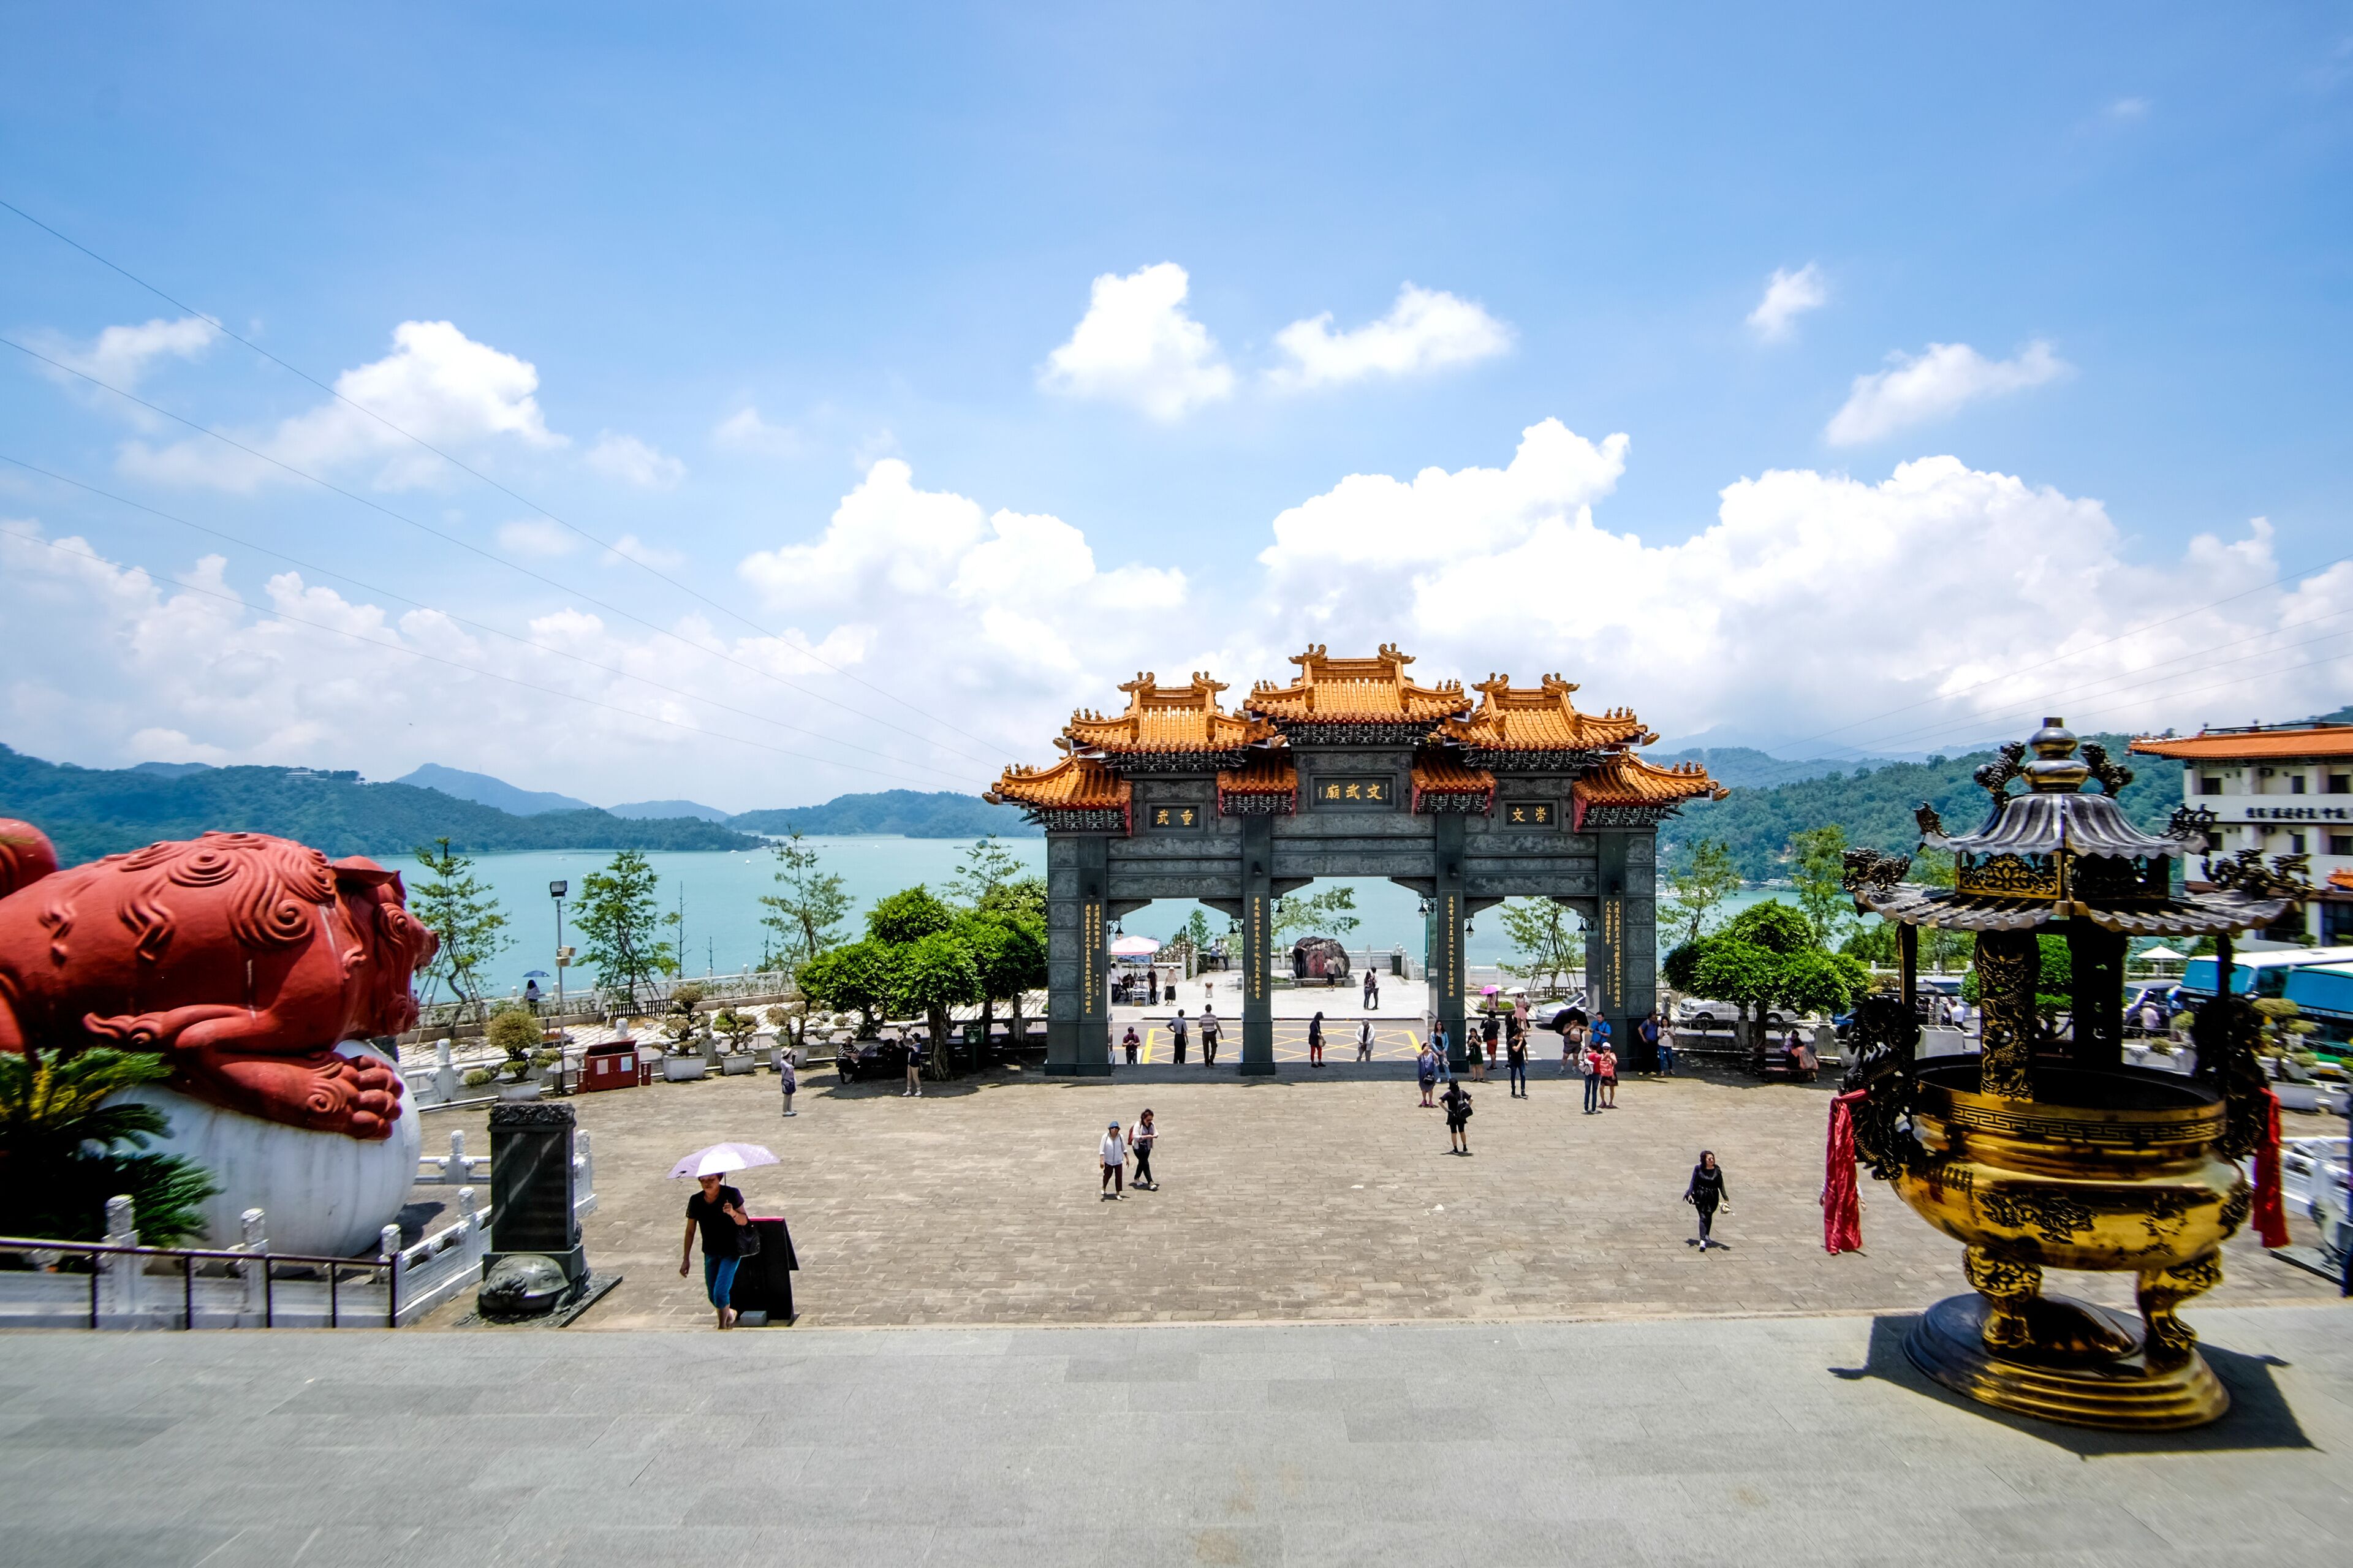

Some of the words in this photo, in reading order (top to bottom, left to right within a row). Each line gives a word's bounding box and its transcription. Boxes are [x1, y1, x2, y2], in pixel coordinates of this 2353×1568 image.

[1325, 783, 1383, 800] 文武廟
[1511, 806, 1547, 822] 崇文
